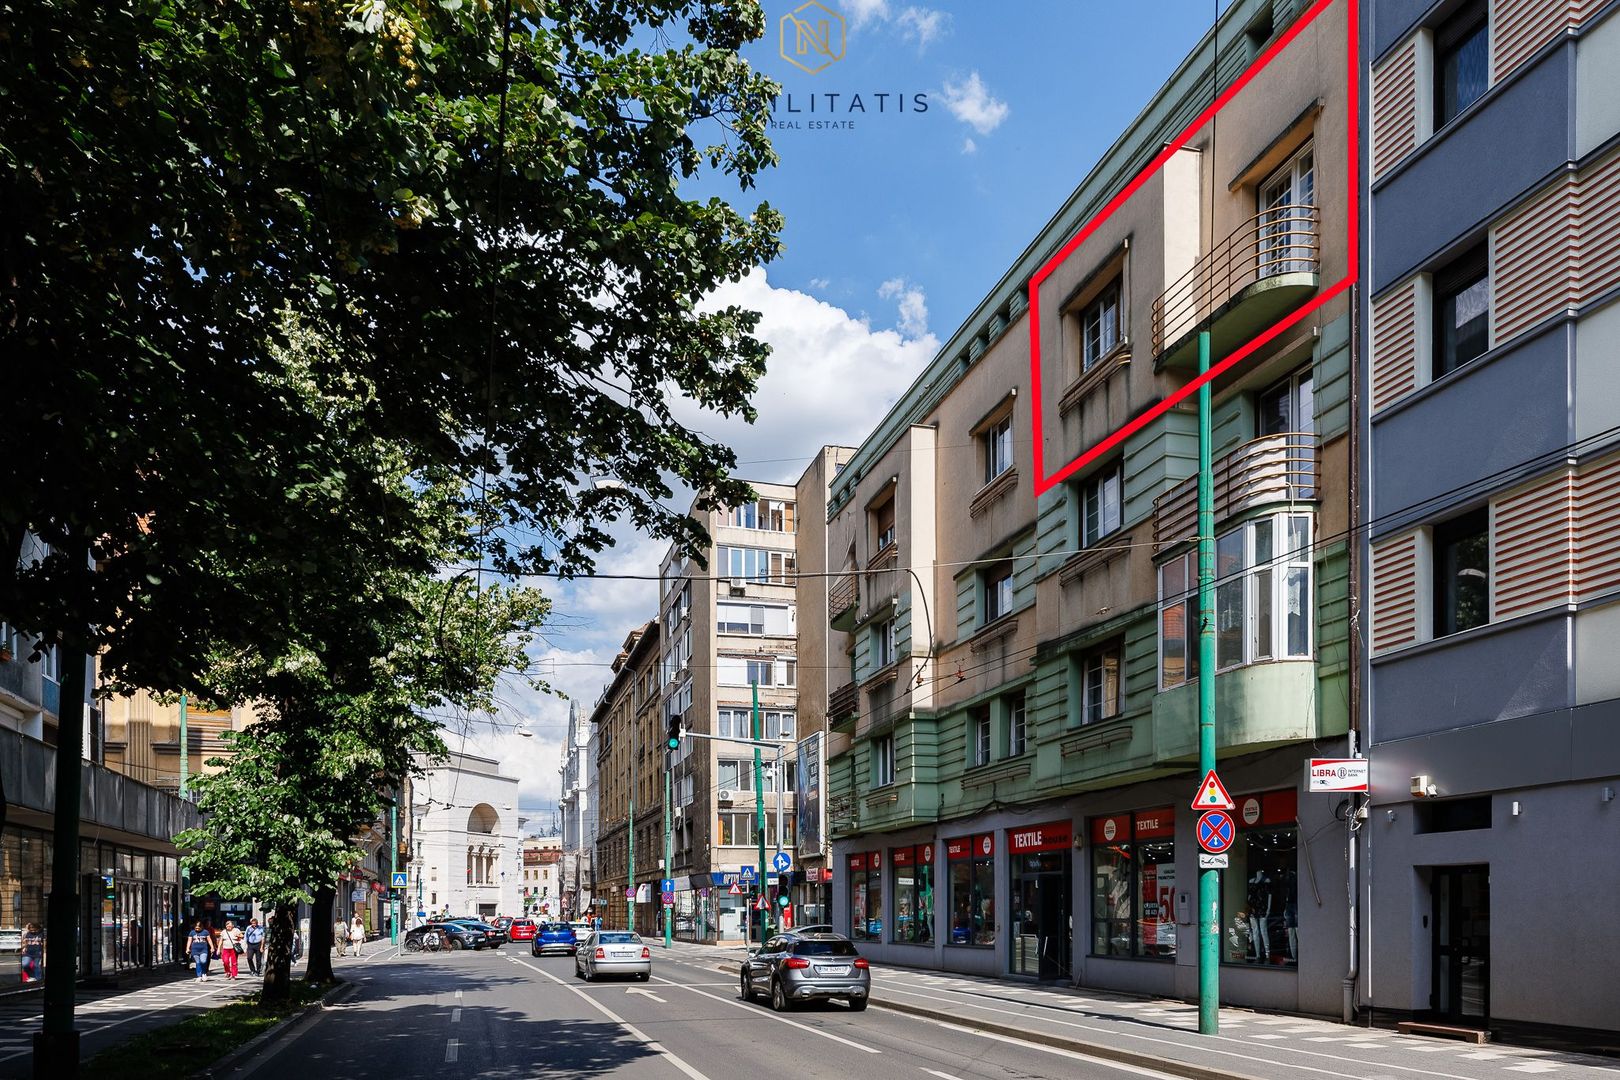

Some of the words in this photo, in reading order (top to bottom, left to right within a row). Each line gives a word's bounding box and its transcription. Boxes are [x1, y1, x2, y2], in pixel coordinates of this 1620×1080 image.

[1312, 769, 1336, 777] LIBRA
[1136, 818, 1159, 831] TEXTILE
[1014, 830, 1042, 848] TEXTILE
